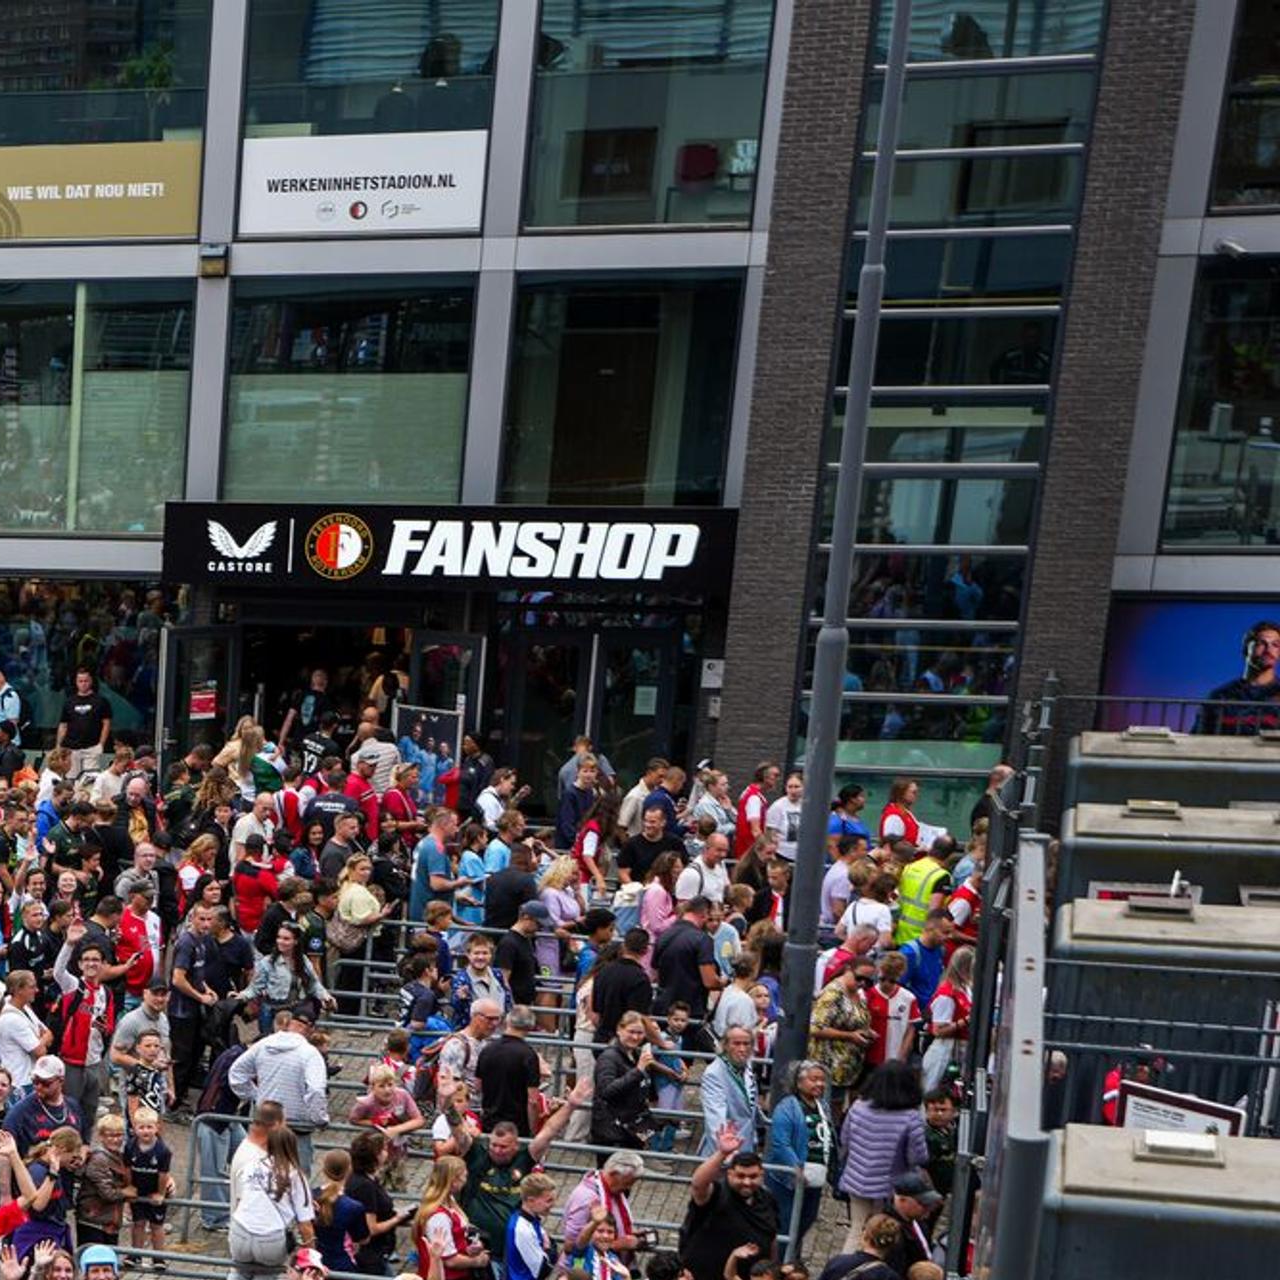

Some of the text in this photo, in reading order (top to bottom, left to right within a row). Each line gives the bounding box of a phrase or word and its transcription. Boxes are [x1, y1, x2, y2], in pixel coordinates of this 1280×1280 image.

[7, 182, 164, 200] WIE WIL DAT NOU NIET!
[267, 173, 457, 193] WERKENINHETSTADION.NL
[382, 520, 701, 580] FANSHOP
[207, 561, 273, 573] CASTORE
